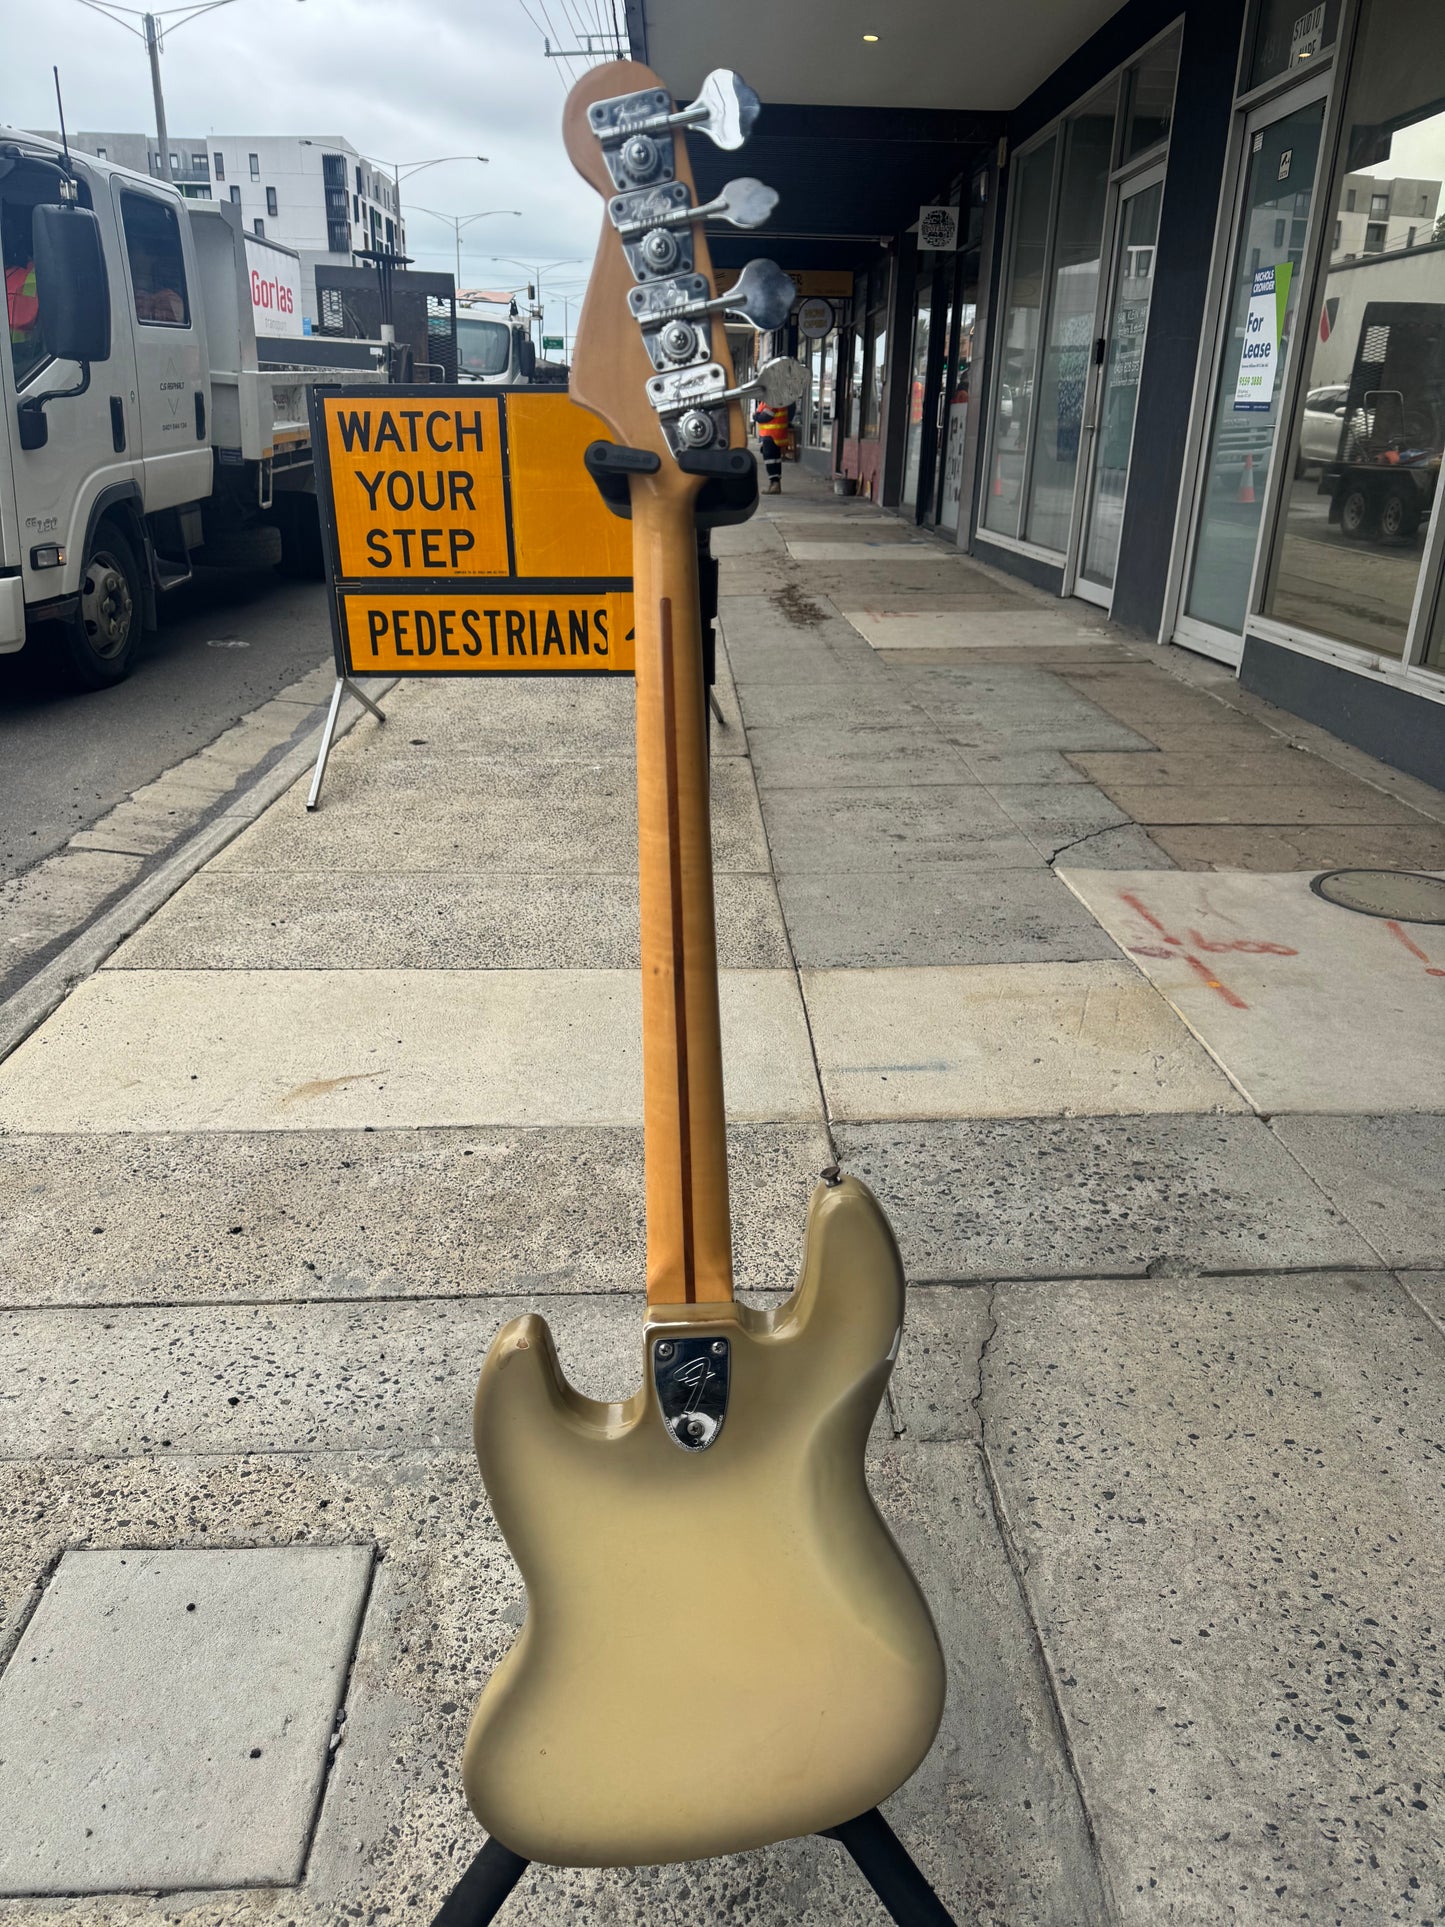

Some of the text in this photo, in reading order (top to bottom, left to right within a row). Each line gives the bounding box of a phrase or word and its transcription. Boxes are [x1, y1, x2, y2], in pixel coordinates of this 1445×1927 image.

[1294, 7, 1321, 41] STUDIO
[252, 269, 294, 314] Gorlas
[1252, 280, 1275, 293] CROWDER
[1254, 269, 1275, 282] NICHOLS
[1246, 311, 1264, 333] For
[1242, 338, 1272, 359] Lease
[337, 410, 484, 453] WATCH
[354, 470, 476, 512] YOUR
[366, 528, 475, 569] STEP
[367, 609, 609, 656] PEDESTRIANS
